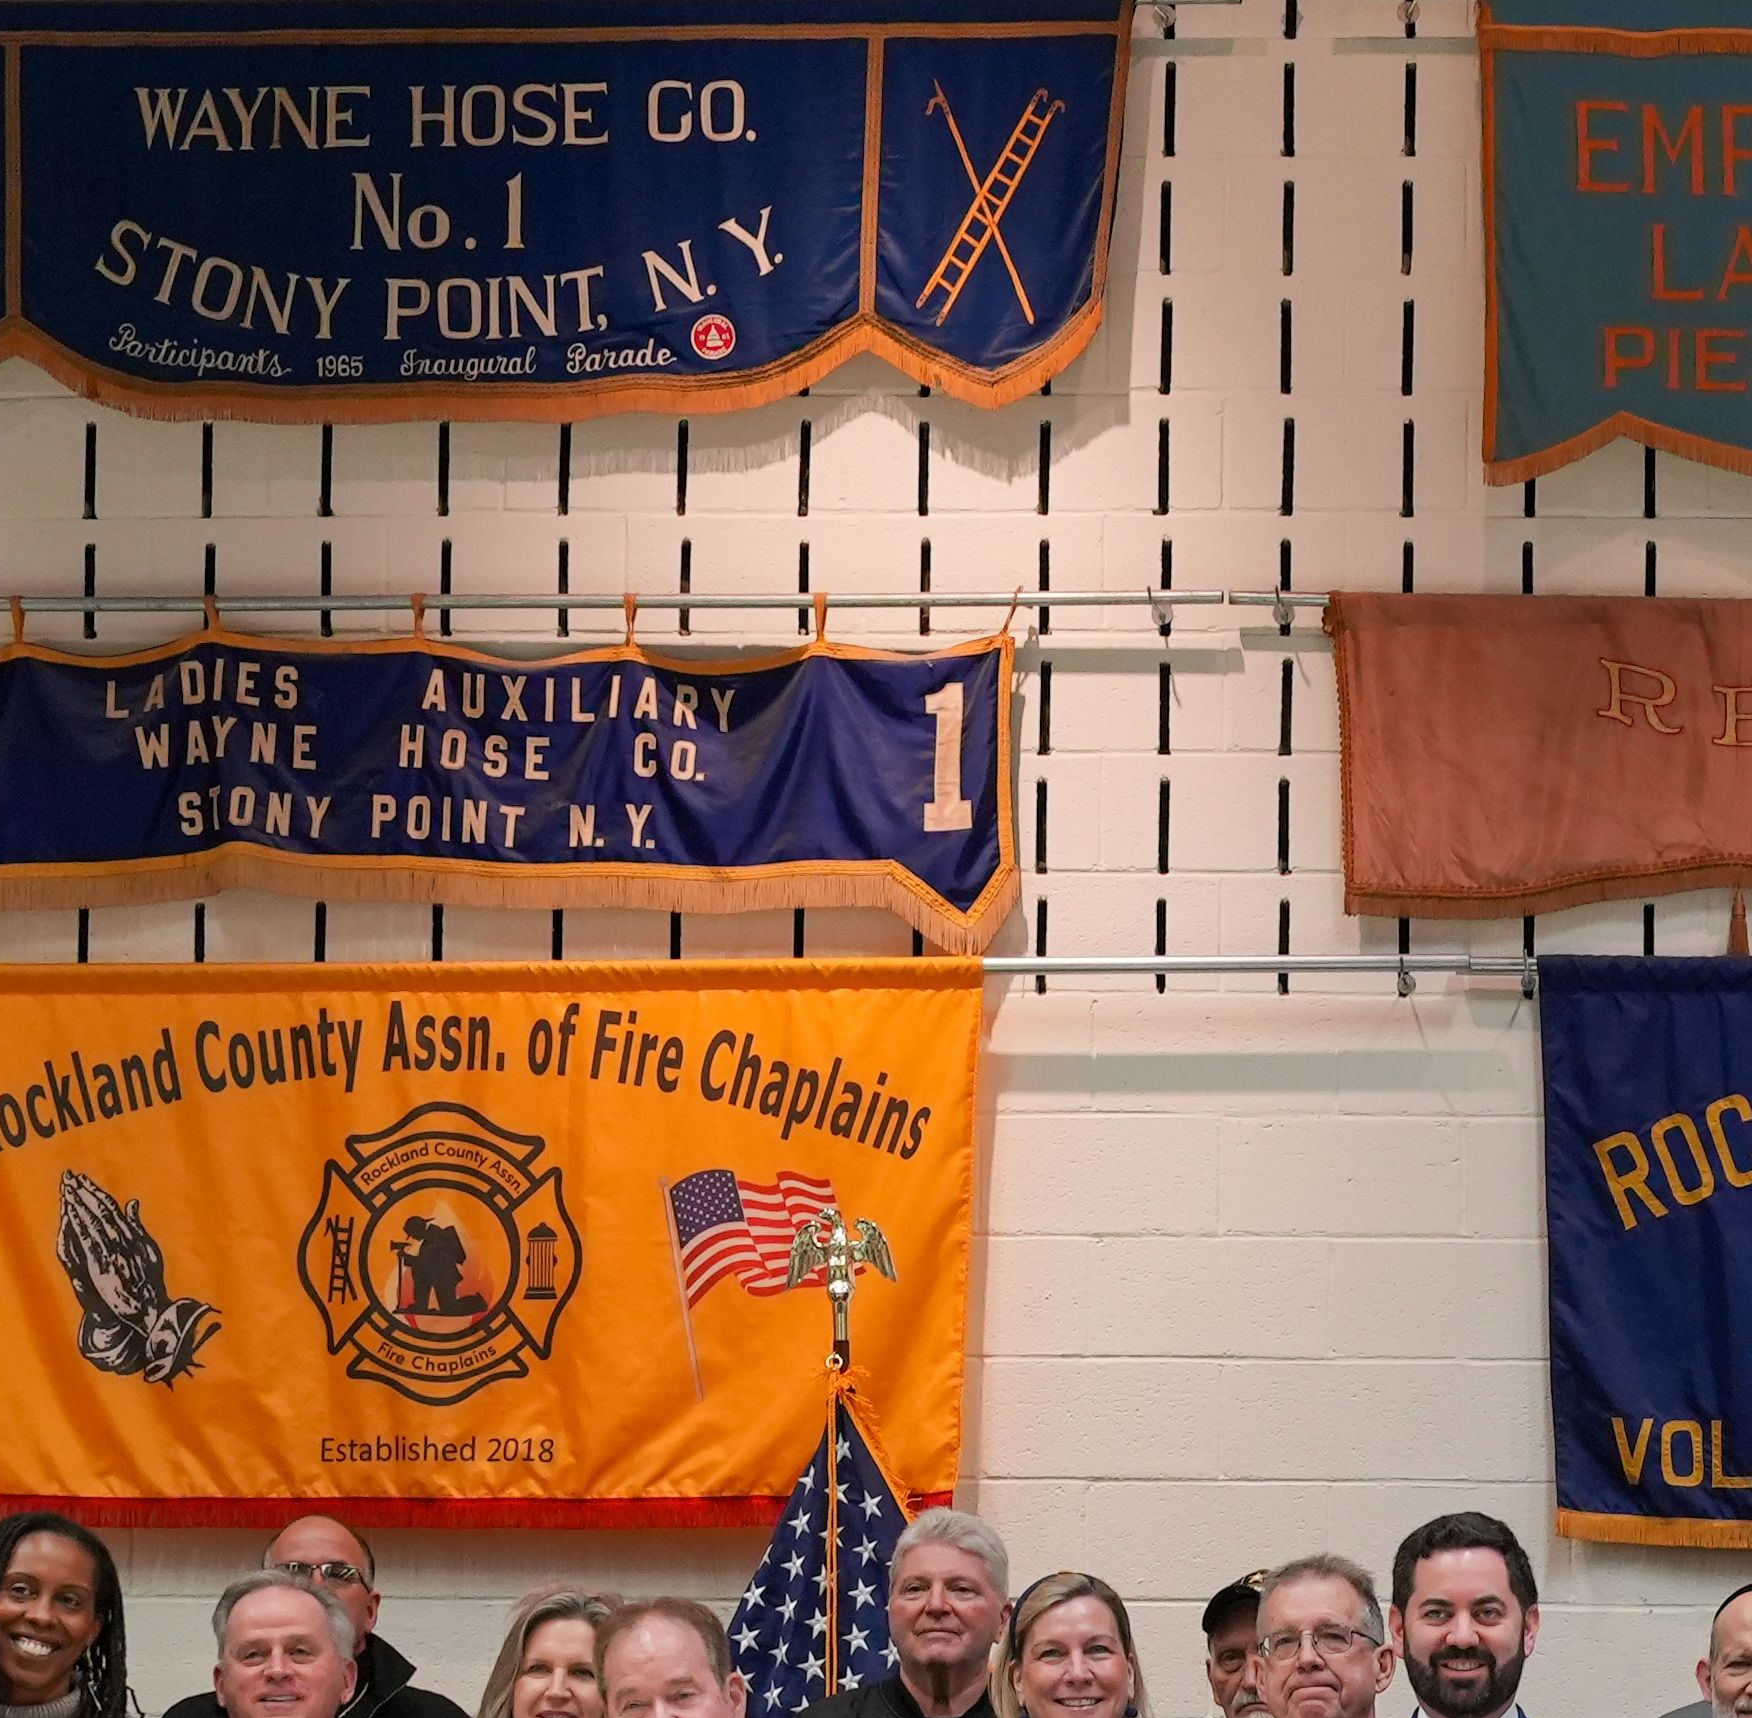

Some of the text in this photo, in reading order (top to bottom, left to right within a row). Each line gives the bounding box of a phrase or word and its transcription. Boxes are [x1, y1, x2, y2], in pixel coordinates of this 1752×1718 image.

[133, 79, 758, 155] WAYNE HOSE CO.
[350, 172, 527, 255] No. 1
[94, 205, 787, 341] STONY POINT, N. Y.
[109, 323, 677, 381] Participants 1965 Inaugural Parade
[107, 660, 738, 734] LADIES AUXILIARY
[137, 722, 706, 782] WAYNE HOSE CO.
[920, 681, 974, 833] 1
[178, 790, 657, 851] STONY POINT N.Y.
[194, 1006, 365, 1093] County
[381, 1000, 509, 1073] Assn.
[528, 1001, 579, 1077] of
[590, 1010, 685, 1093] Fire
[699, 1029, 935, 1163] Chaplains
[360, 1143, 524, 1194] Rockland County Assn.
[377, 1342, 497, 1374] Fire Chaplains
[320, 1434, 554, 1463] Established 2018
